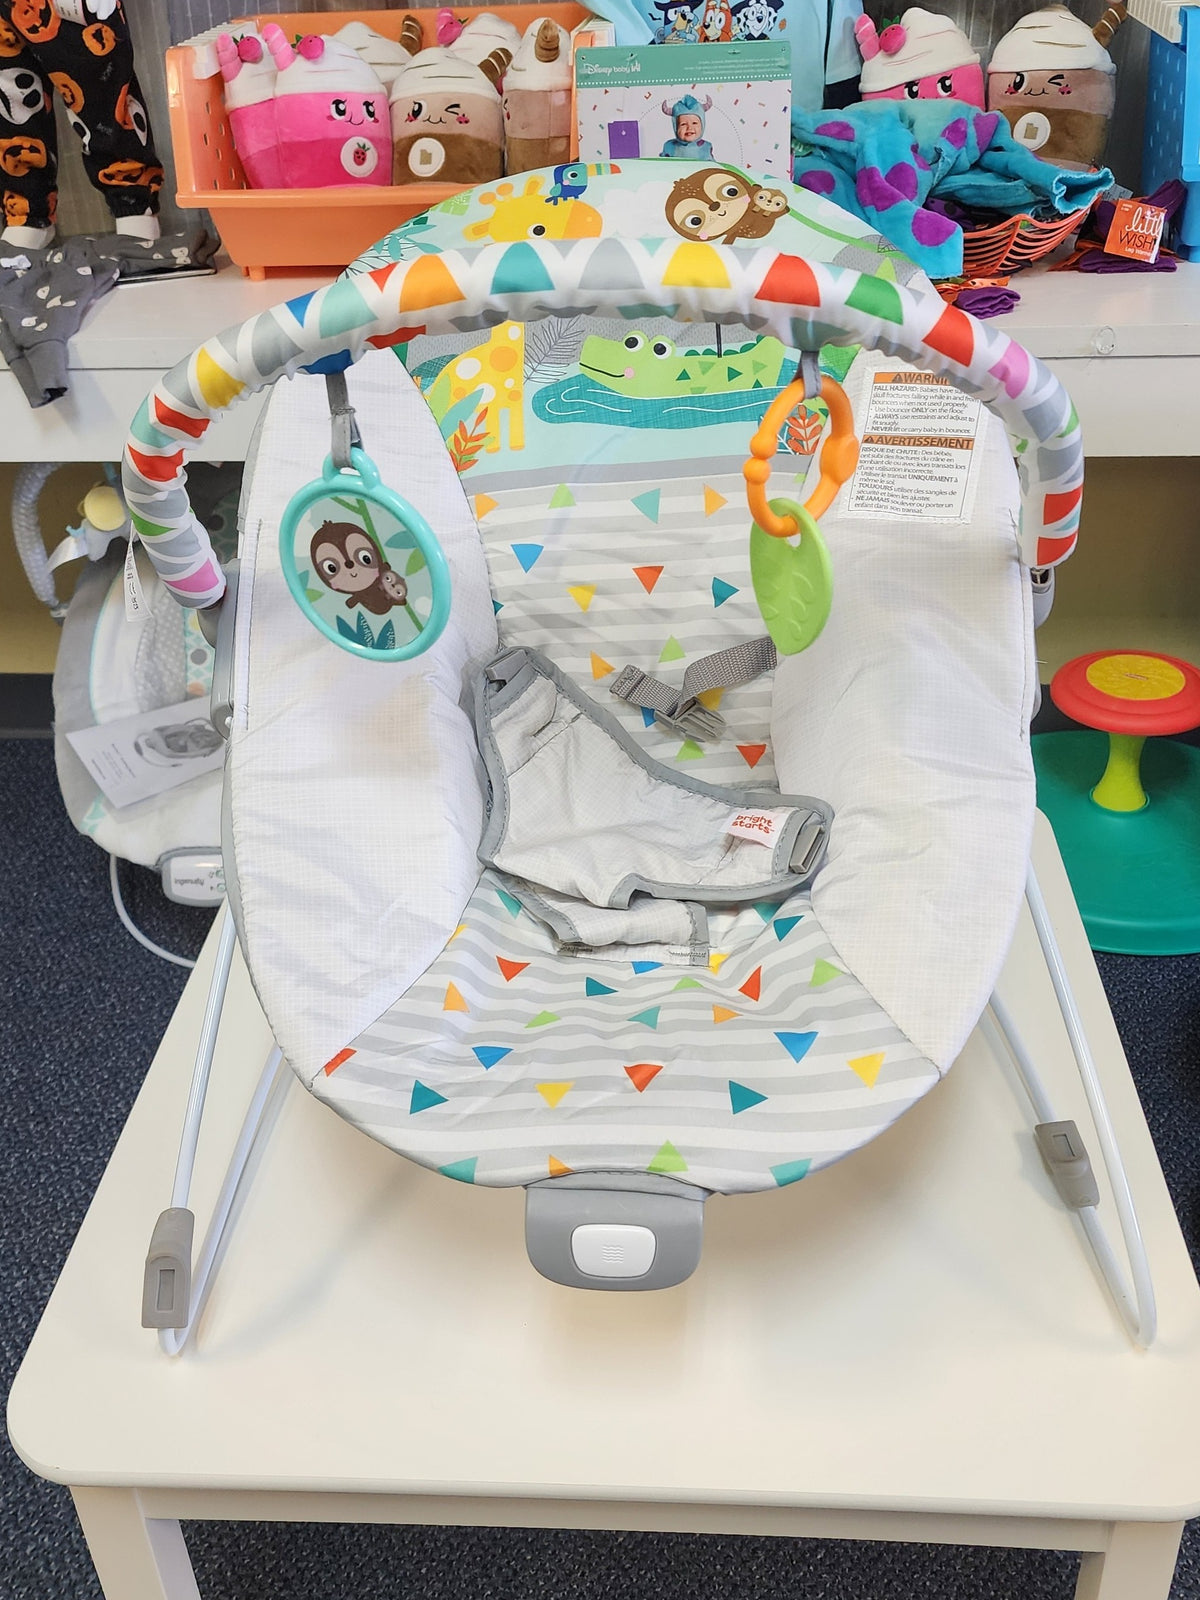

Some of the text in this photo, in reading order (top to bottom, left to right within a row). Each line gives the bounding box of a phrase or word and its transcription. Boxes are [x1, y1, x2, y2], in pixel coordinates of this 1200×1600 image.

[584, 63, 612, 76] Disney
[903, 373, 948, 385] WARNI
[876, 436, 973, 449] AVERTISSEMENT
[908, 474, 953, 482] UNIQUEMENT
[736, 815, 772, 827] bright
